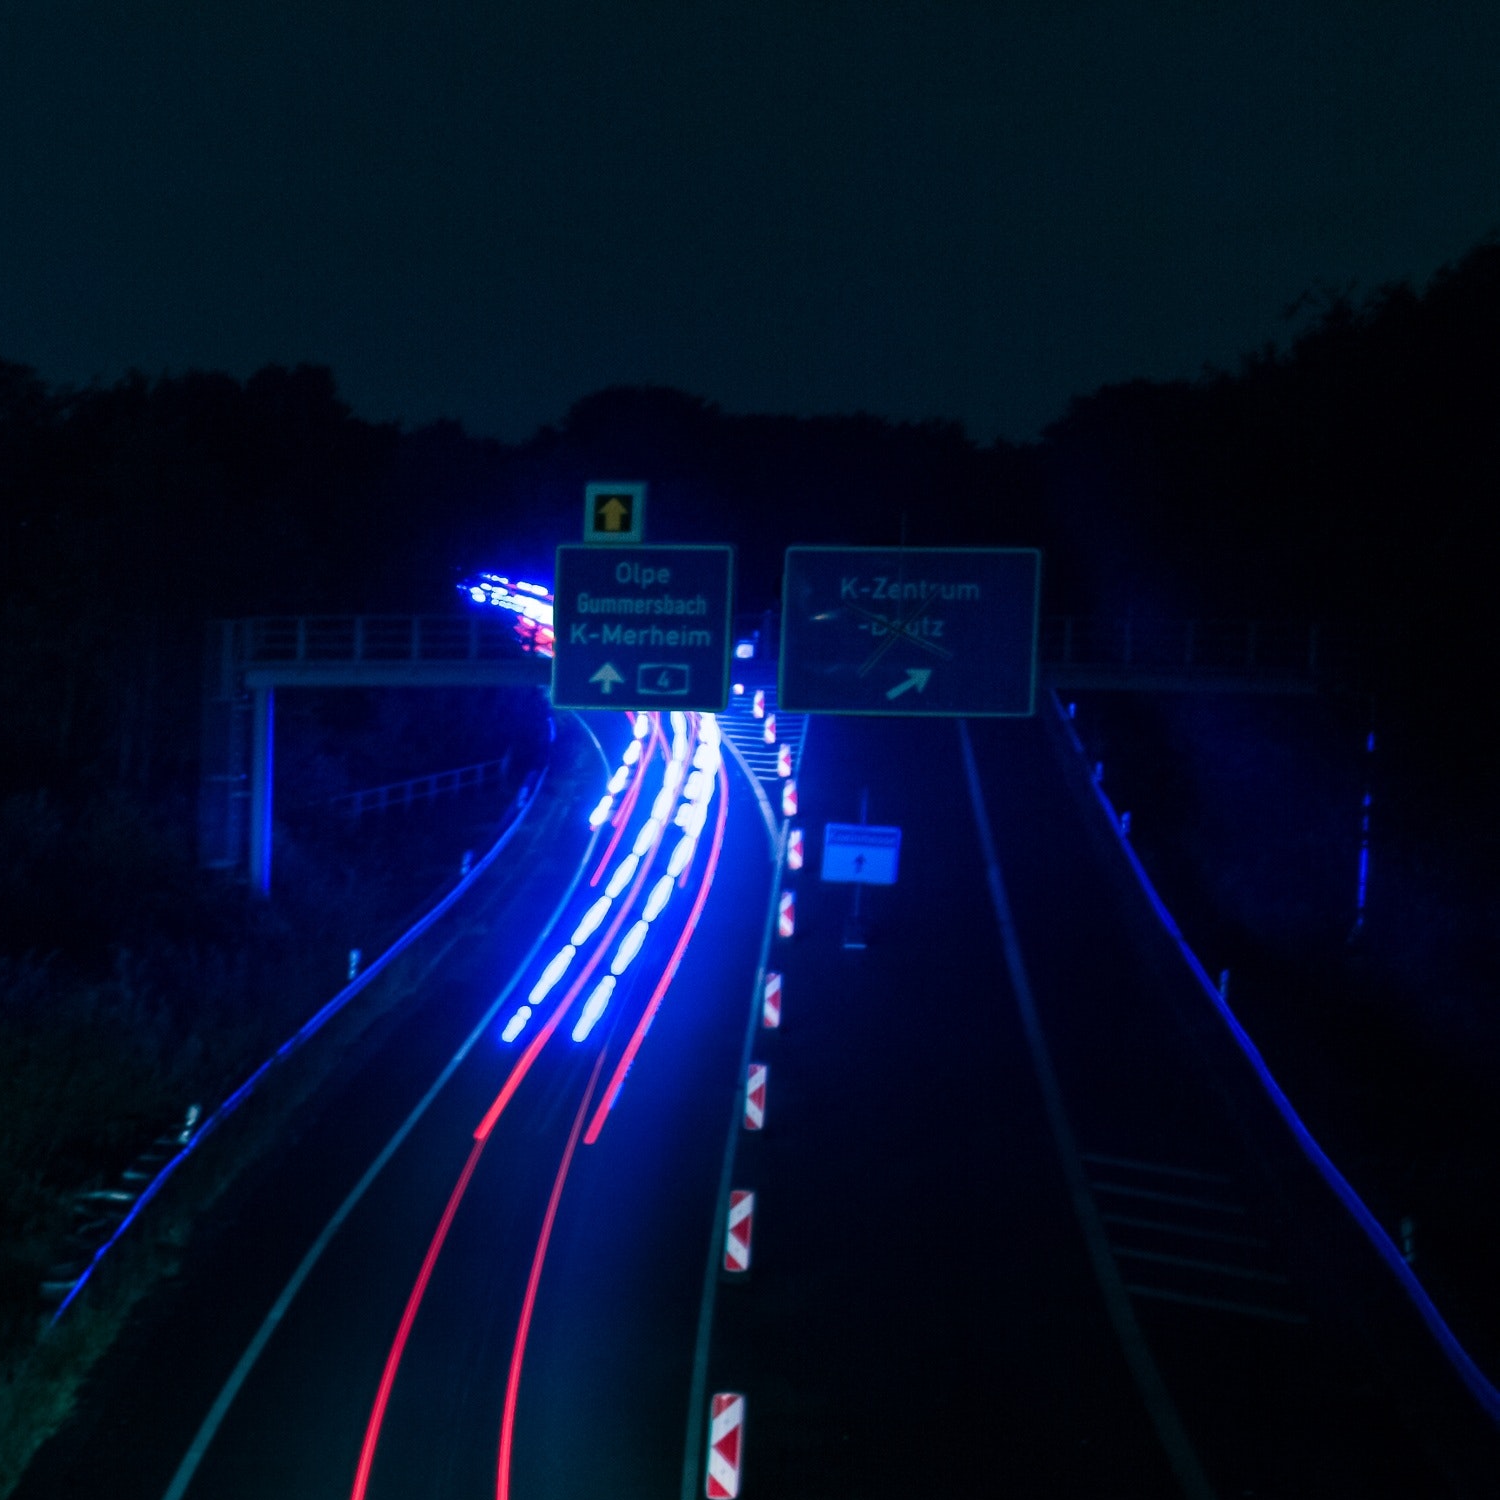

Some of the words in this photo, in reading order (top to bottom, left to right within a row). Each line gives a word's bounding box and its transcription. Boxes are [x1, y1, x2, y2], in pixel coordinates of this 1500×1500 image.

[615, 561, 671, 589] Olpe
[840, 575, 981, 600] K-Zentrum
[577, 592, 708, 616] Gummersbach
[570, 623, 712, 646] K-Merheim
[657, 671, 670, 688] 4
